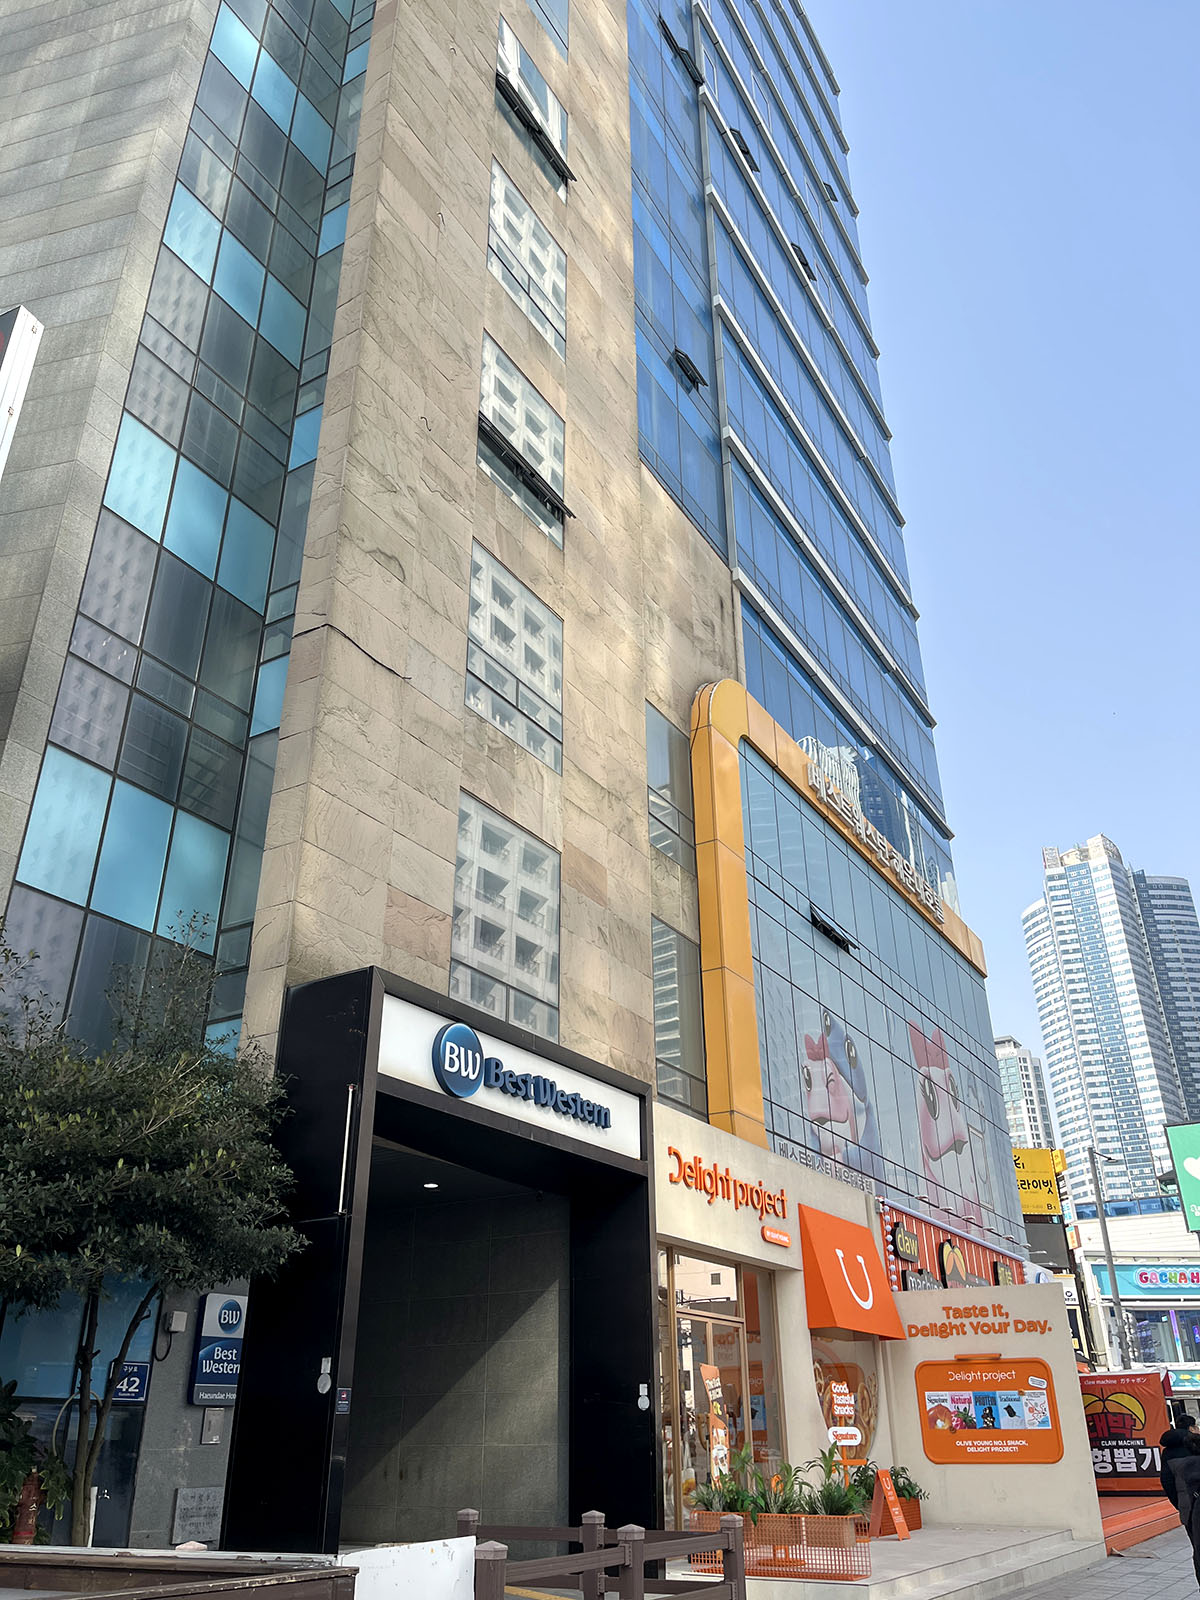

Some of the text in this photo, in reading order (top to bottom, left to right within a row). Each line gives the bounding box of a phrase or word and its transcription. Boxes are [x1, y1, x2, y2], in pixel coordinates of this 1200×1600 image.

[444, 1041, 481, 1080] BW
[483, 1057, 611, 1129] Best Western
[668, 1146, 787, 1220] Delight project
[897, 1230, 918, 1257] claw
[1139, 1272, 1188, 1284] GACHA
[221, 1310, 240, 1324] BW
[942, 1304, 1009, 1319] Taste It,
[907, 1319, 1052, 1339] Delight Your Day.
[214, 1347, 237, 1360] Best
[948, 1371, 981, 1382] Delight
[982, 1370, 1016, 1382] project
[116, 1377, 140, 1392] 42
